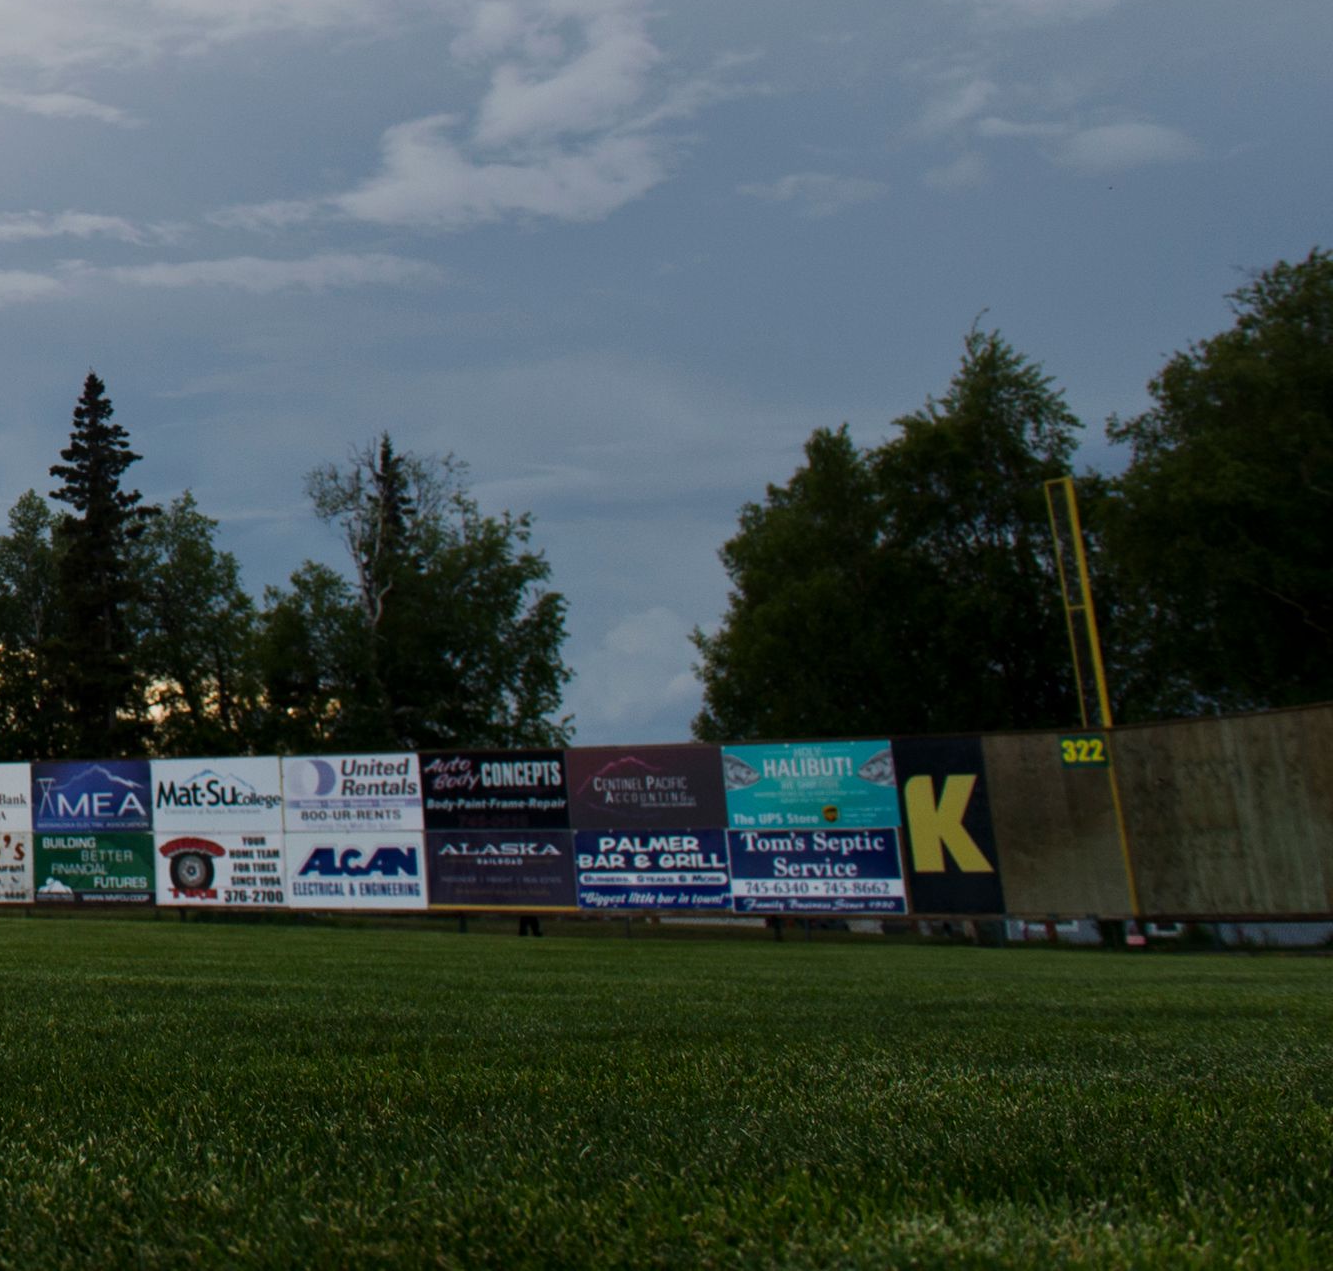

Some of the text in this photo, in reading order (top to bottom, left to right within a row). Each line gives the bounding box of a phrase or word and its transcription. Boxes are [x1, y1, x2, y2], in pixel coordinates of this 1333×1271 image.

[1061, 739, 1105, 763] 322
[341, 758, 408, 777] United
[425, 757, 471, 774] Auto
[763, 757, 853, 777] HALIBUT!
[481, 761, 561, 787] CONCEPTS
[341, 779, 417, 796] Rentals
[434, 773, 480, 790] Body
[593, 776, 687, 791] CENTINEL PACIFIC
[237, 792, 281, 808] College
[605, 791, 687, 804] ACCOUNTING
[58, 793, 145, 816] MEA
[301, 809, 401, 820] 800-UR-RENTS
[733, 813, 820, 825] The UPS Store
[904, 774, 994, 872] K
[42, 837, 96, 848] BUILDING
[242, 836, 265, 845] YOUR
[599, 837, 699, 852] PALMER
[741, 831, 885, 855] Tom's Septic
[81, 849, 133, 862] BETTER
[229, 849, 279, 859] HOME TEAM
[439, 843, 561, 855] ALASKA
[234, 862, 276, 872] FOR TIRES
[578, 854, 726, 868] BAR & GRILL
[773, 857, 858, 877] Service
[51, 863, 108, 875] FINANCIAL
[94, 876, 148, 888] FUTURES
[231, 876, 256, 886] SINCE
[745, 881, 890, 894] 745-6340 745-8662
[293, 882, 421, 897] ELECTRICAL & ENGINEERING
[224, 890, 283, 903] 376-2700
[581, 892, 731, 905] "Biggest little bar in town!"
[743, 898, 865, 911] Family Business Since
